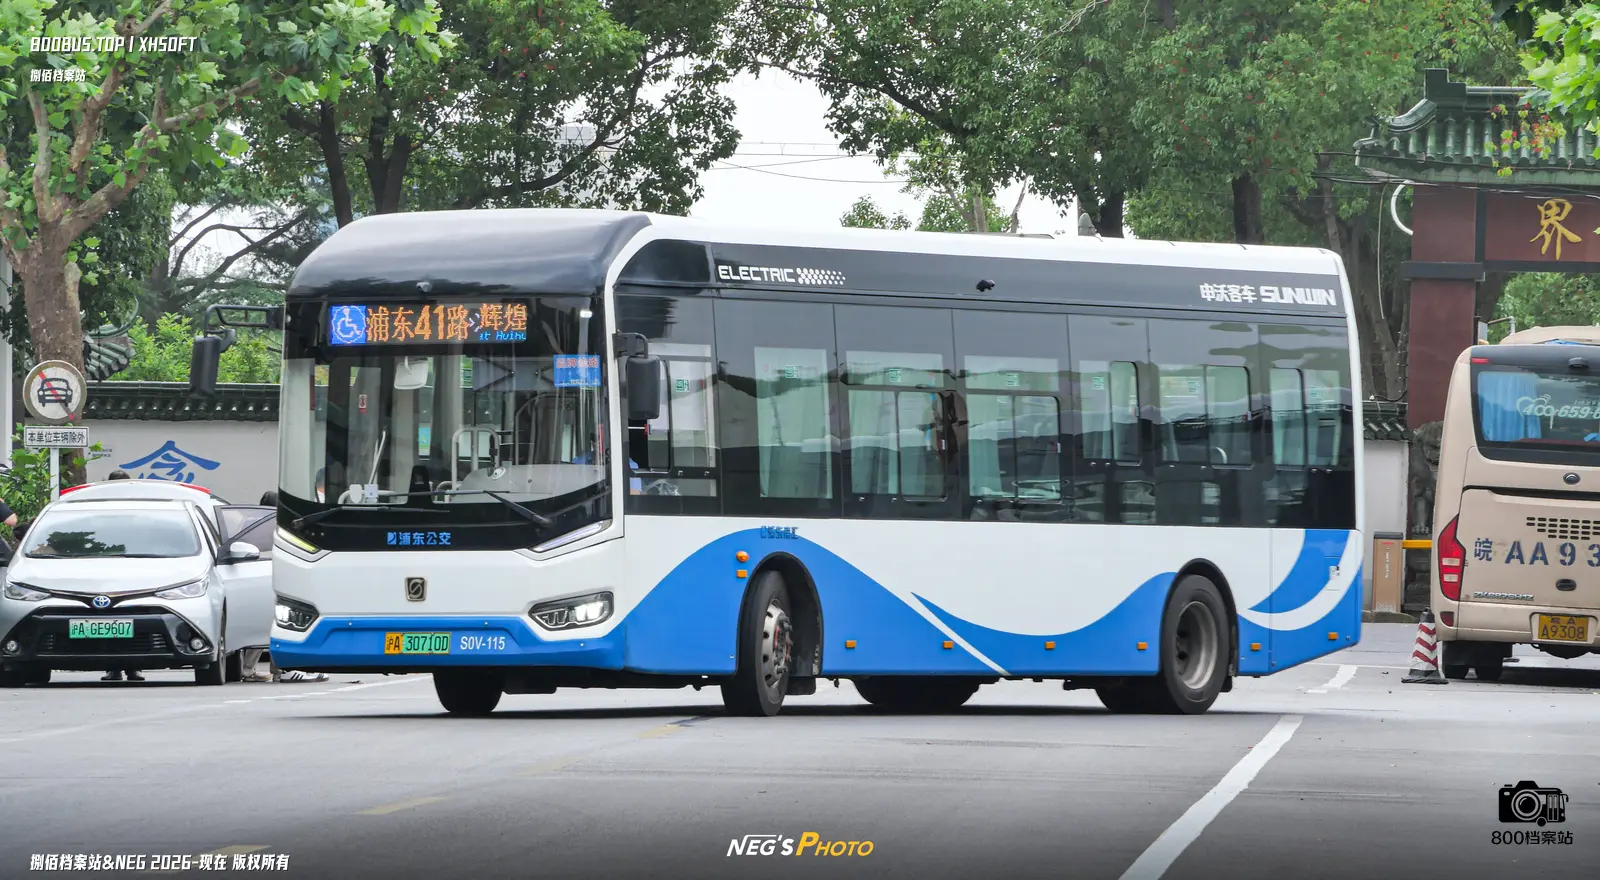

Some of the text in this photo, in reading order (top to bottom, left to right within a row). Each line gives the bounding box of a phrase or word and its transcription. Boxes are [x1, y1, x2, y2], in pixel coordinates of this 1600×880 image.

[1529, 198, 1582, 261] 界
[717, 265, 796, 283] ELECTRIC
[1199, 282, 1338, 306] 申沃客车 SUNWIN
[366, 303, 527, 342] 浦东41路 辉煌
[28, 431, 85, 444] 本单位车辆除外
[398, 531, 451, 545] 浦东公交
[1541, 625, 1585, 640] A9308
